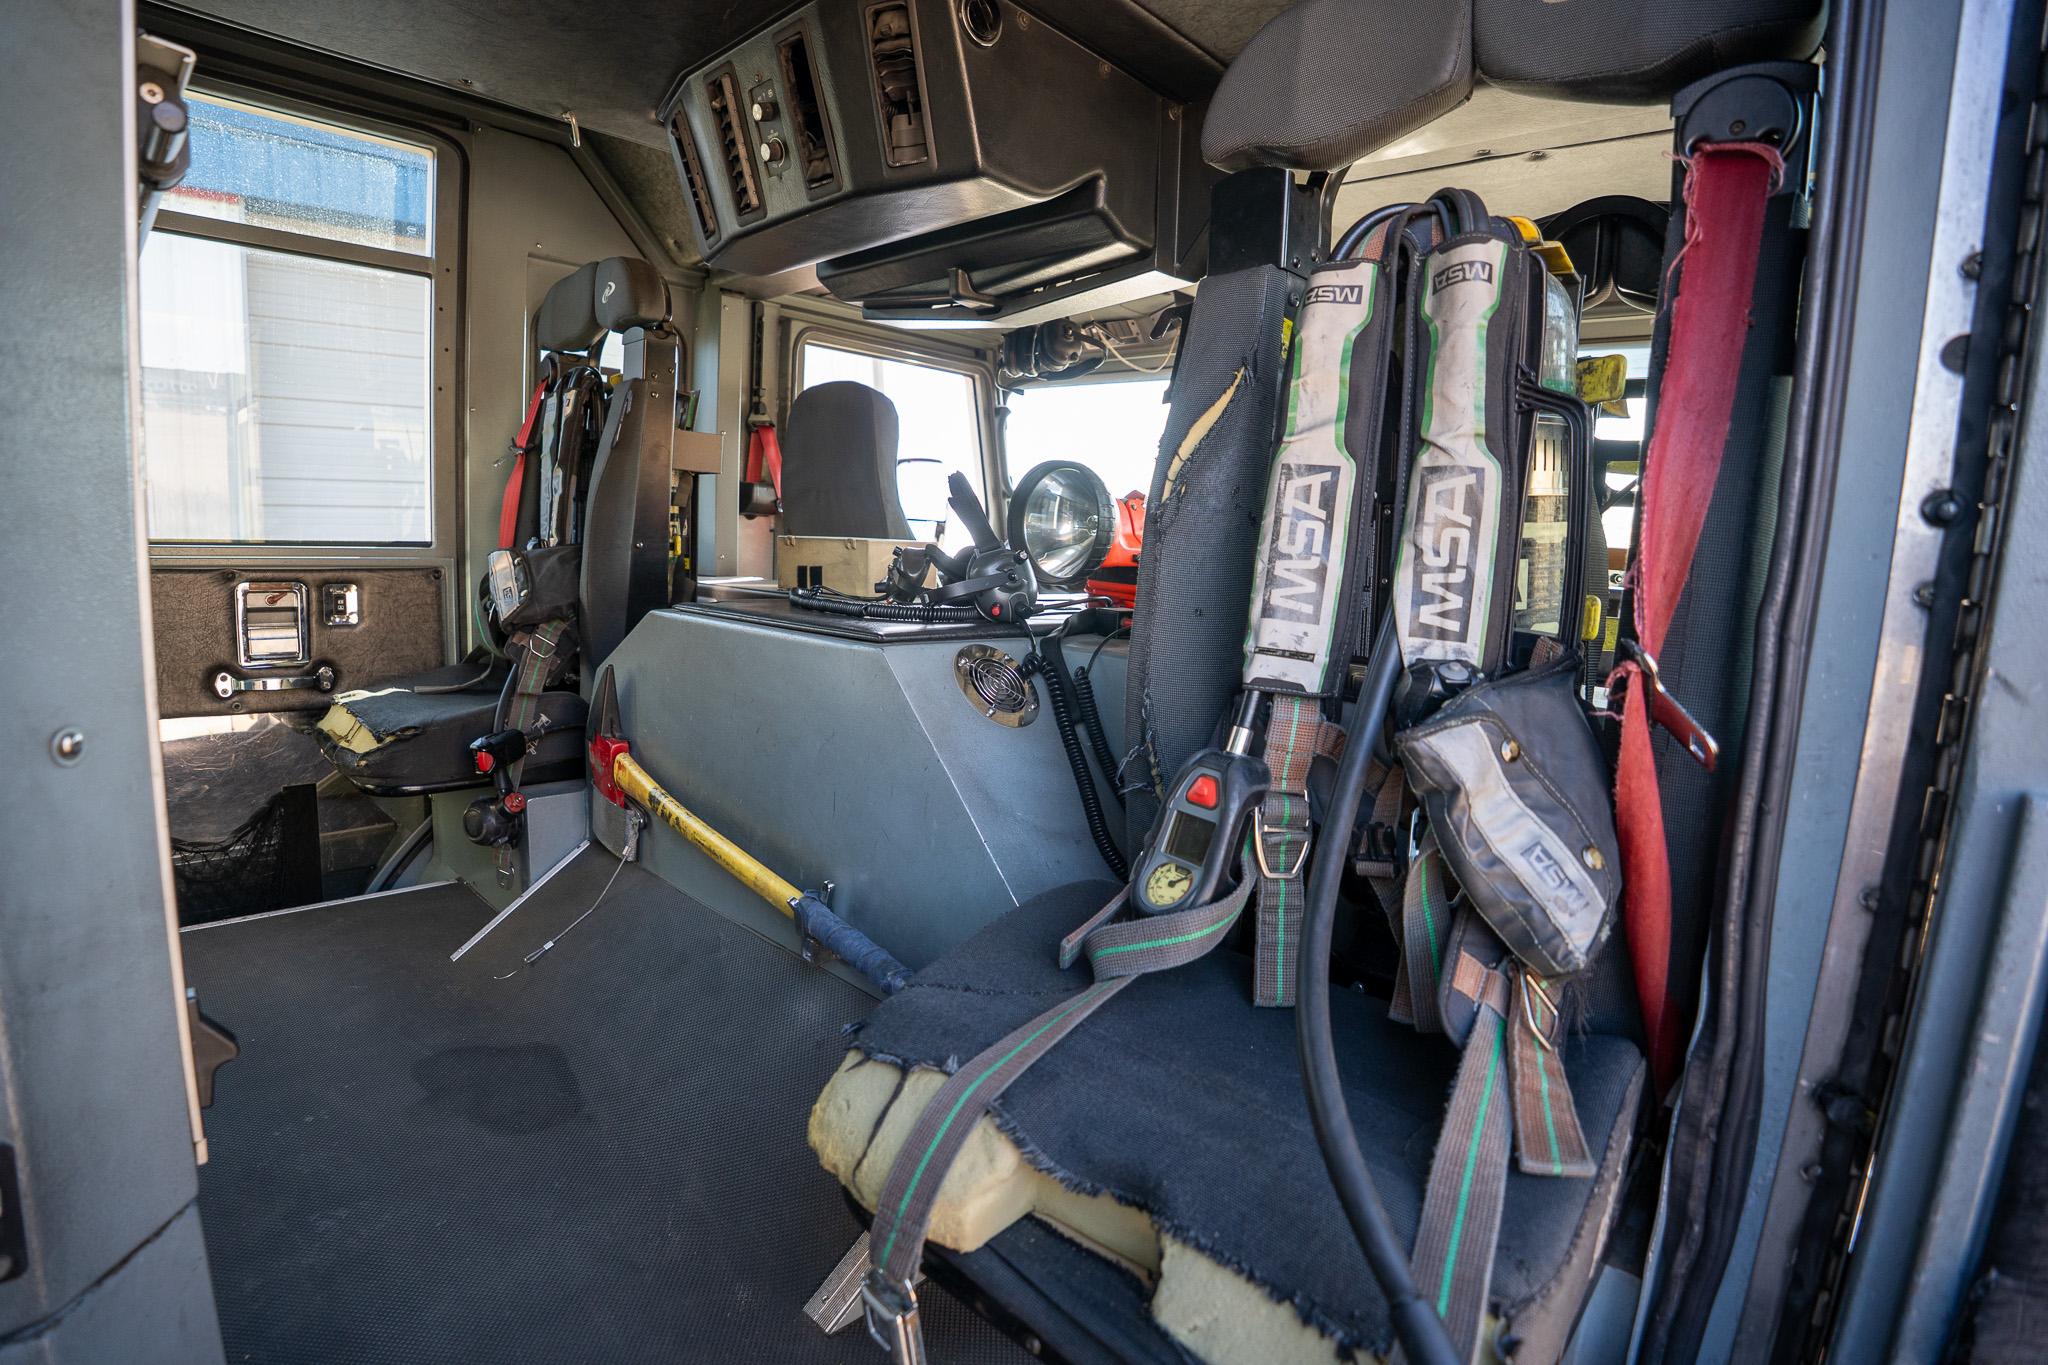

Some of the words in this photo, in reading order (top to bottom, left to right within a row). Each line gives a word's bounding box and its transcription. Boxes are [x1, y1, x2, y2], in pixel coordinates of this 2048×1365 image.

[1435, 264, 1490, 289] MSA
[1270, 471, 1332, 614] MSA
[1418, 473, 1477, 632] MSA
